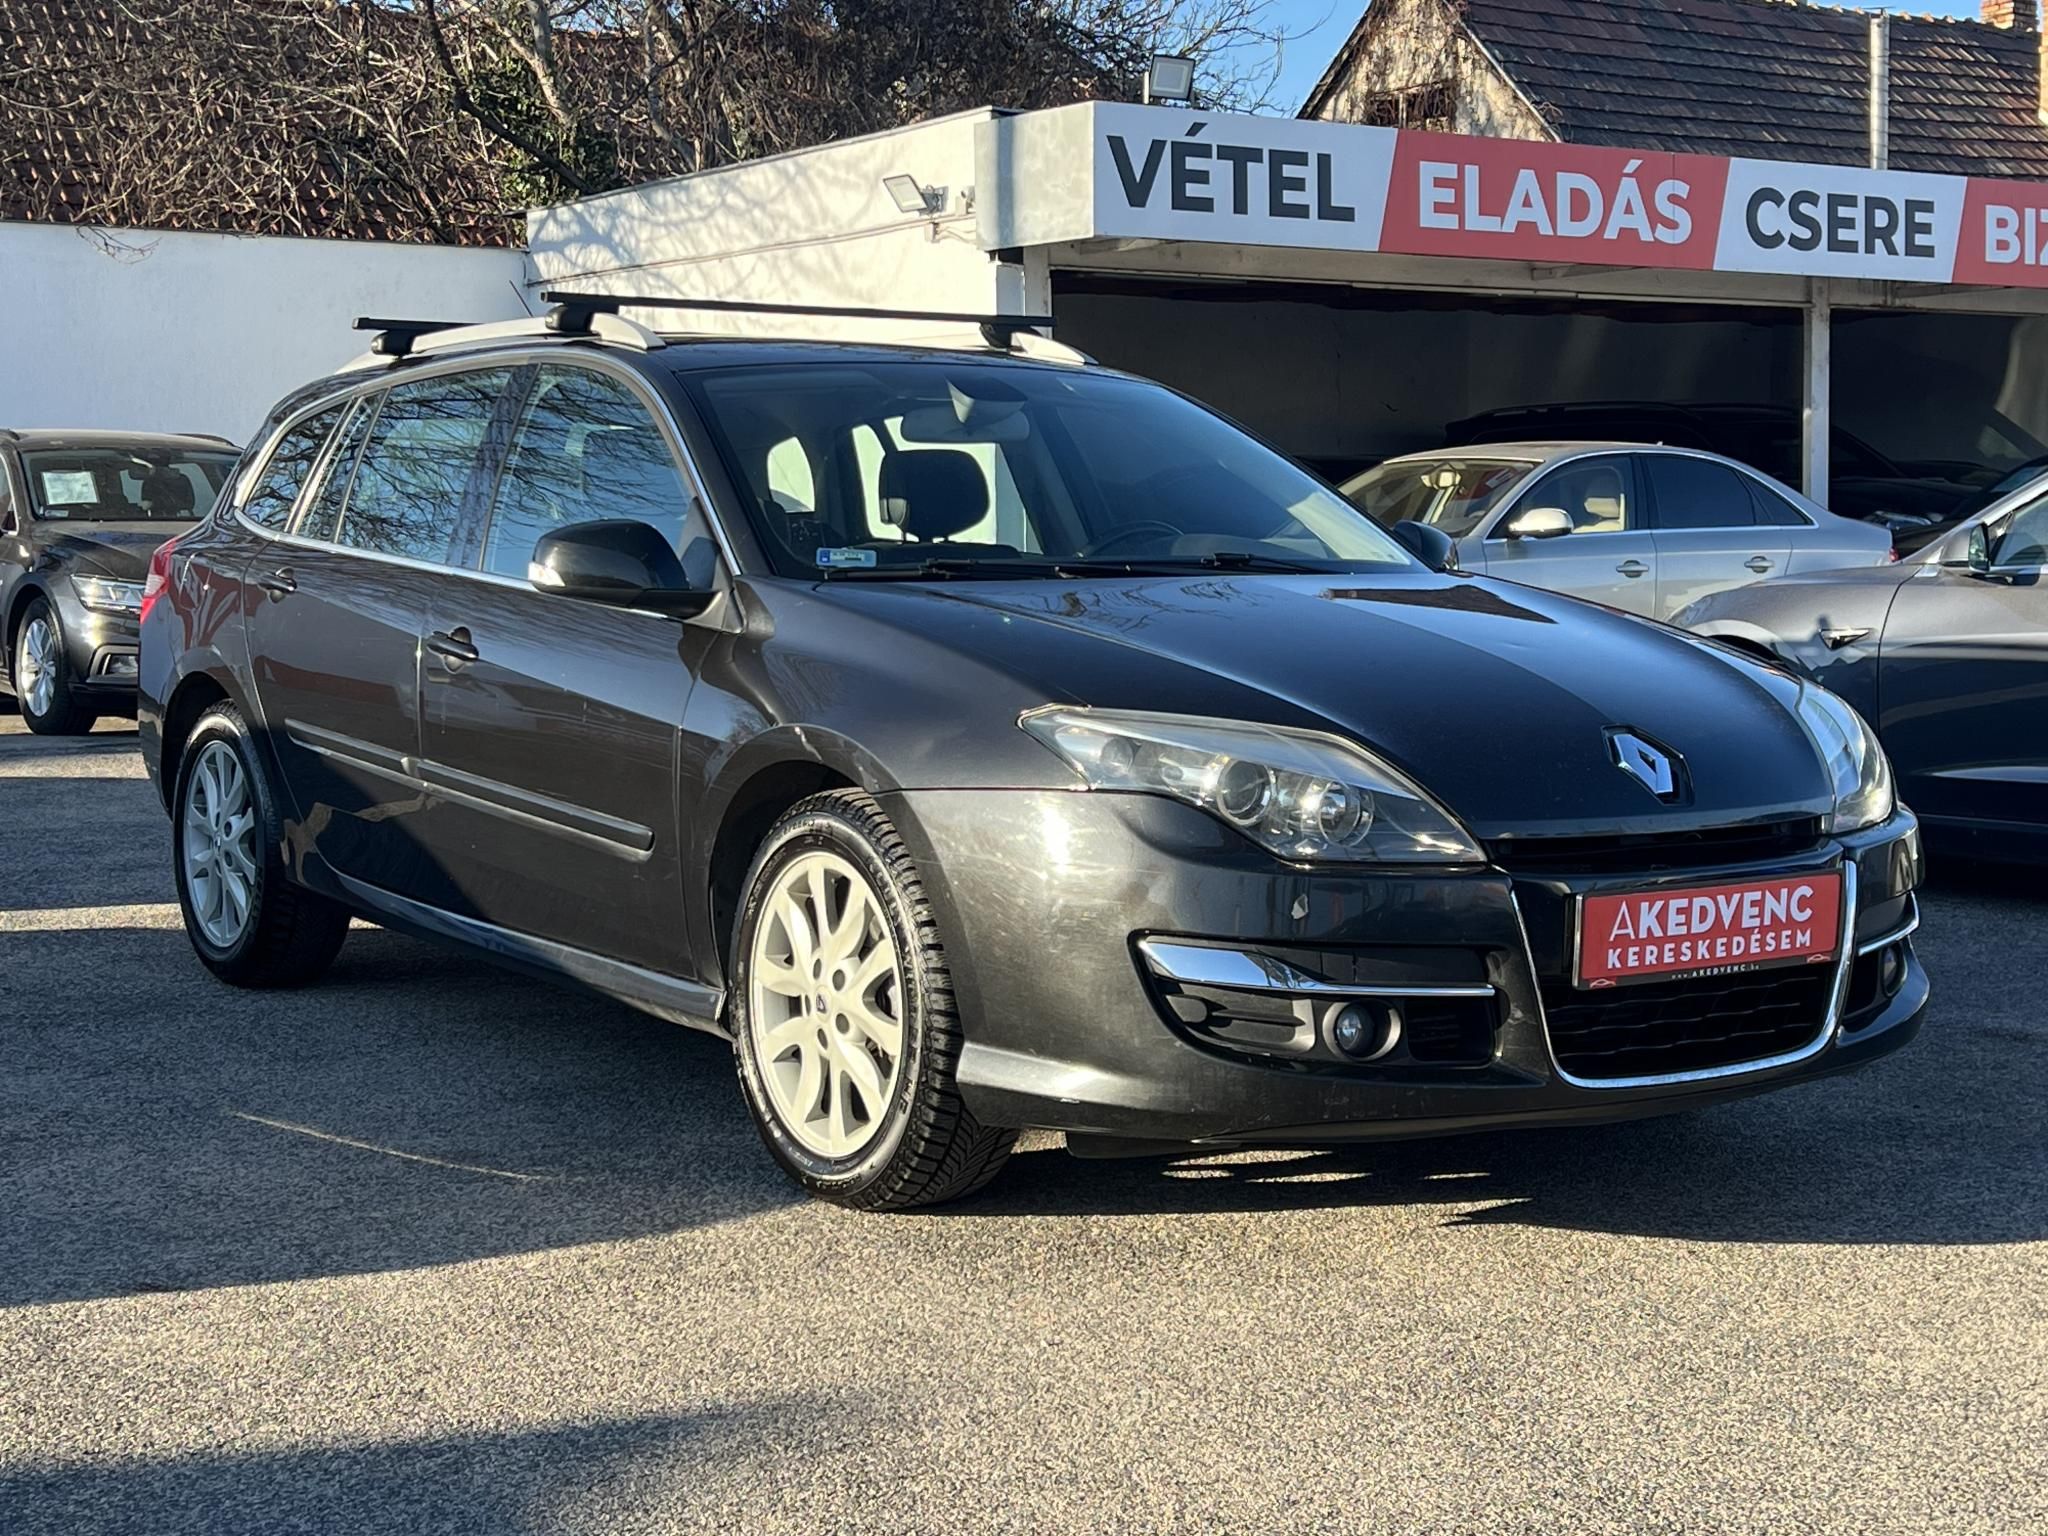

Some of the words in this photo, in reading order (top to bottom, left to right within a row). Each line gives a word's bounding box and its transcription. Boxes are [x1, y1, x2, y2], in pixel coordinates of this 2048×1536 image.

[1107, 121, 1355, 221] VÉTEL
[1419, 158, 1693, 245] ELADÁS
[1745, 187, 1935, 258] CSERE
[1984, 204, 2048, 266] BI
[1609, 885, 1814, 942] AKEDVENC
[1607, 928, 1812, 969] KERESKEDÉSEM
